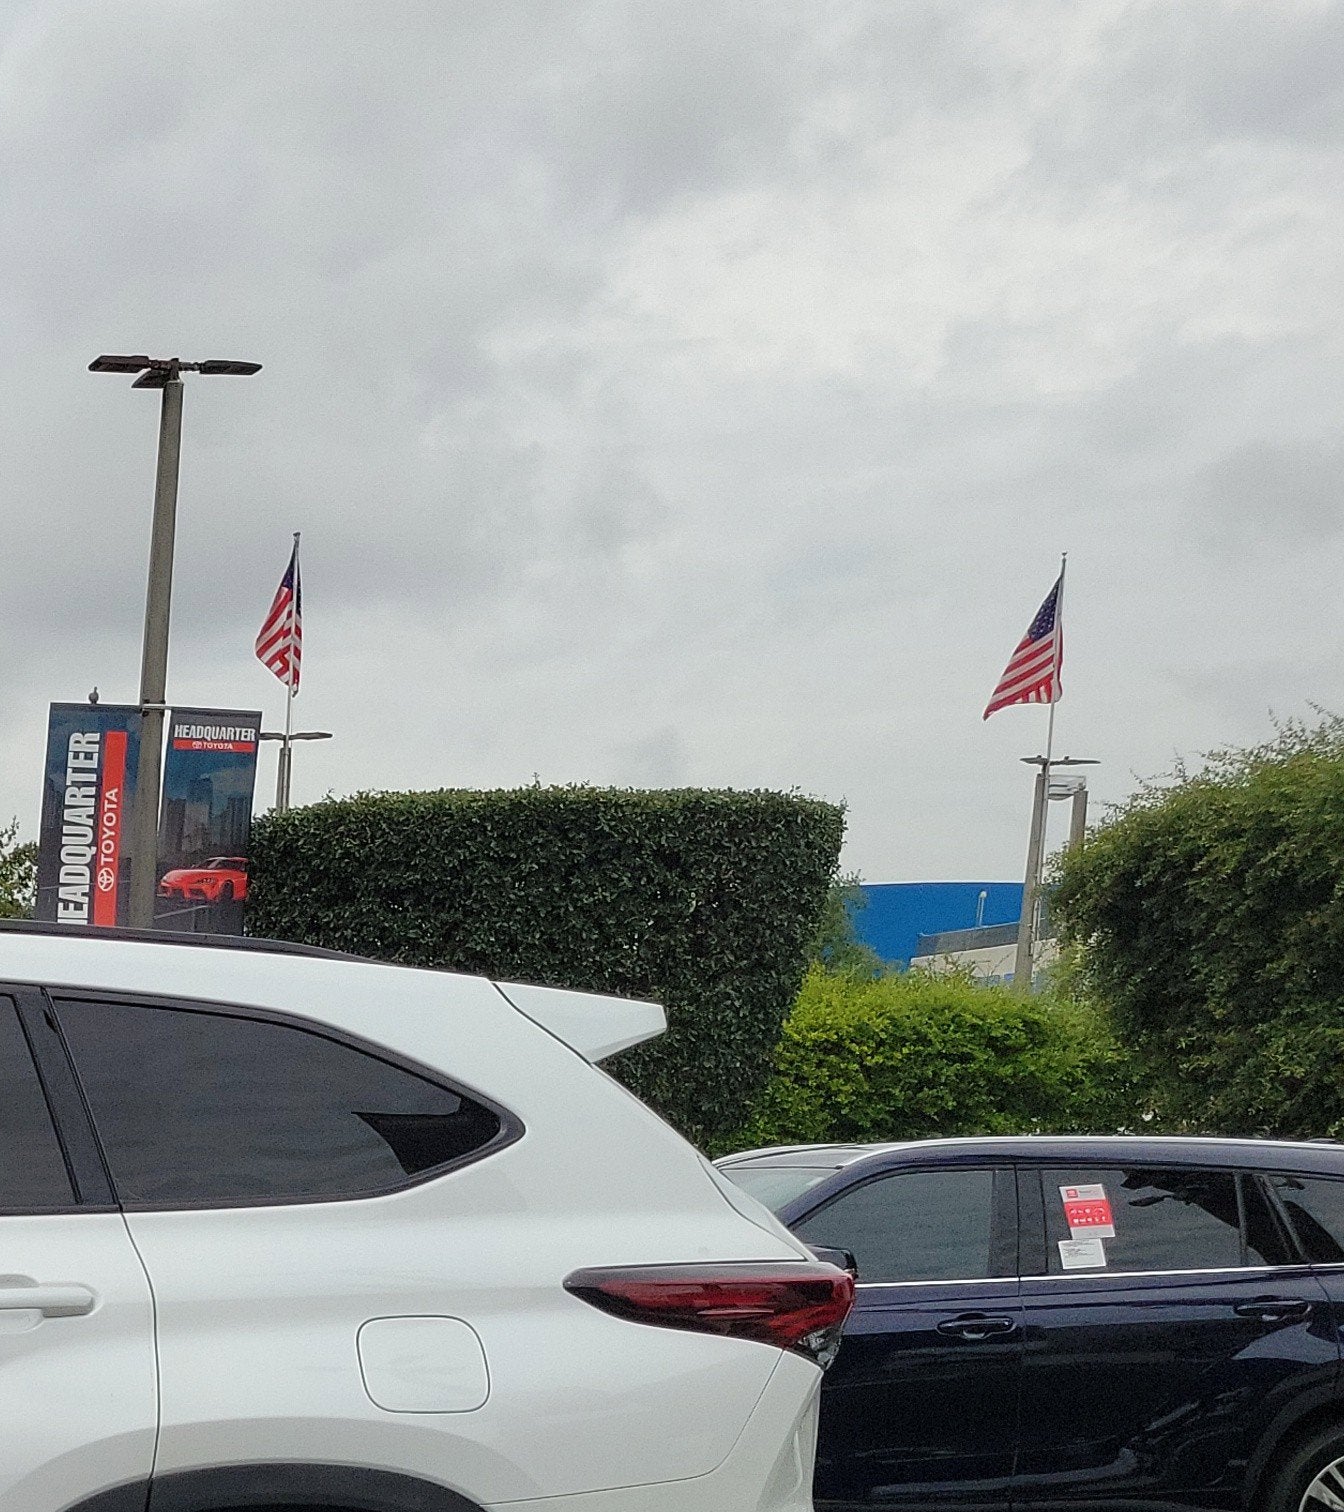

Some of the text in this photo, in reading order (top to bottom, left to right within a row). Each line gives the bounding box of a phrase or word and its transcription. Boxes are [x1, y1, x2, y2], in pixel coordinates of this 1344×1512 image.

[173, 725, 256, 742] HEADQUARTER
[203, 742, 234, 750] TOYOTA
[101, 788, 119, 865] TOYOTA
